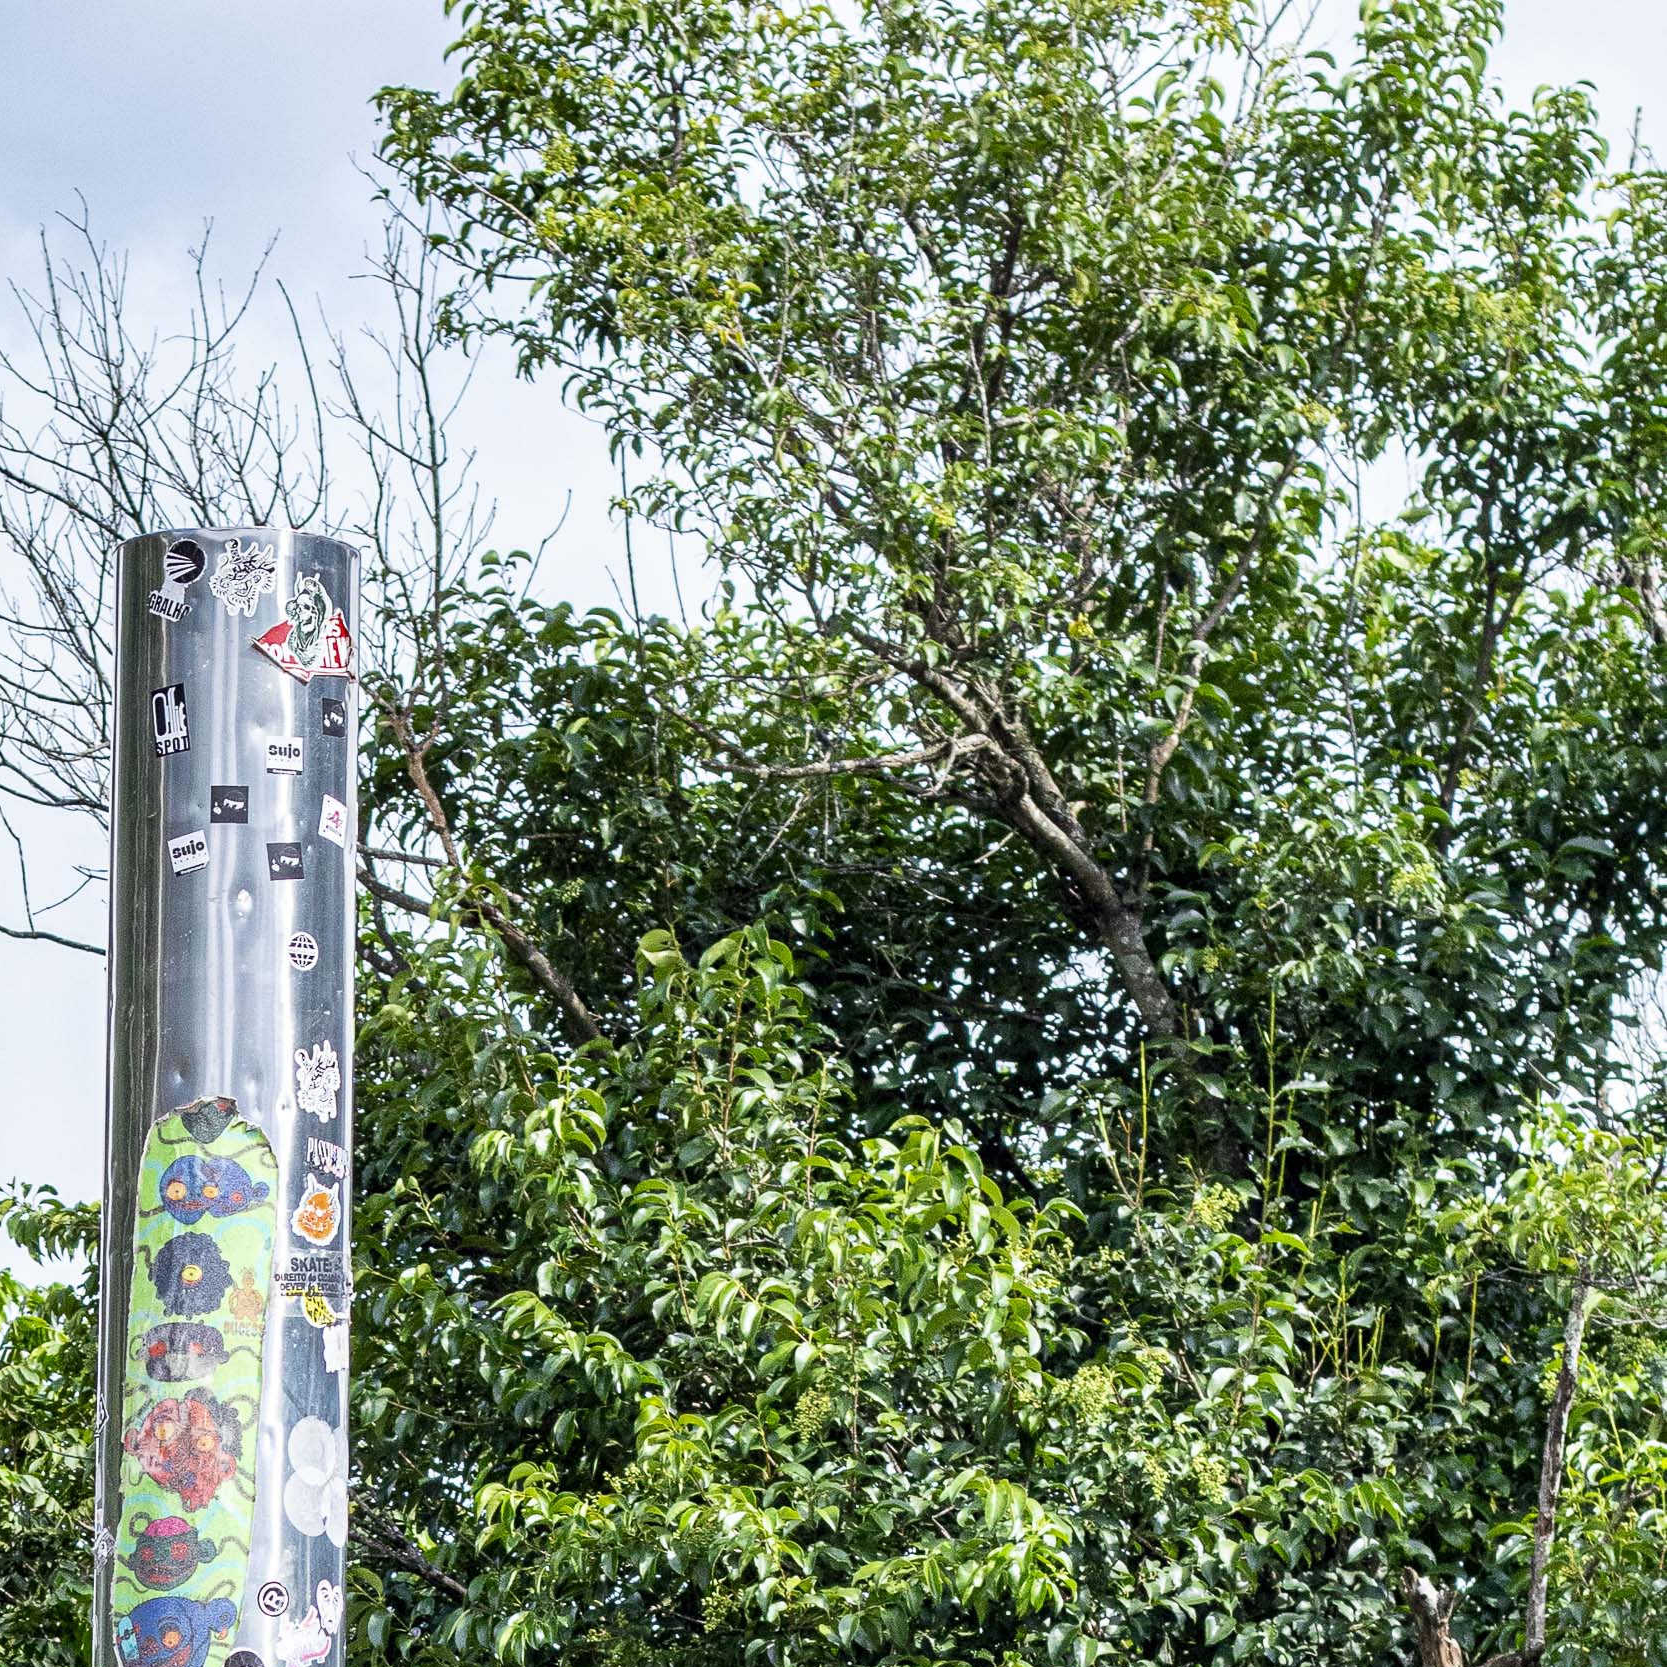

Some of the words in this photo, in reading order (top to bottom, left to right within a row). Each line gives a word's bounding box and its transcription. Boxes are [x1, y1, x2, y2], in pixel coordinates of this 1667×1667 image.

[156, 735, 189, 757] SPOT
[268, 743, 300, 759] sujo
[173, 839, 205, 859] sujo
